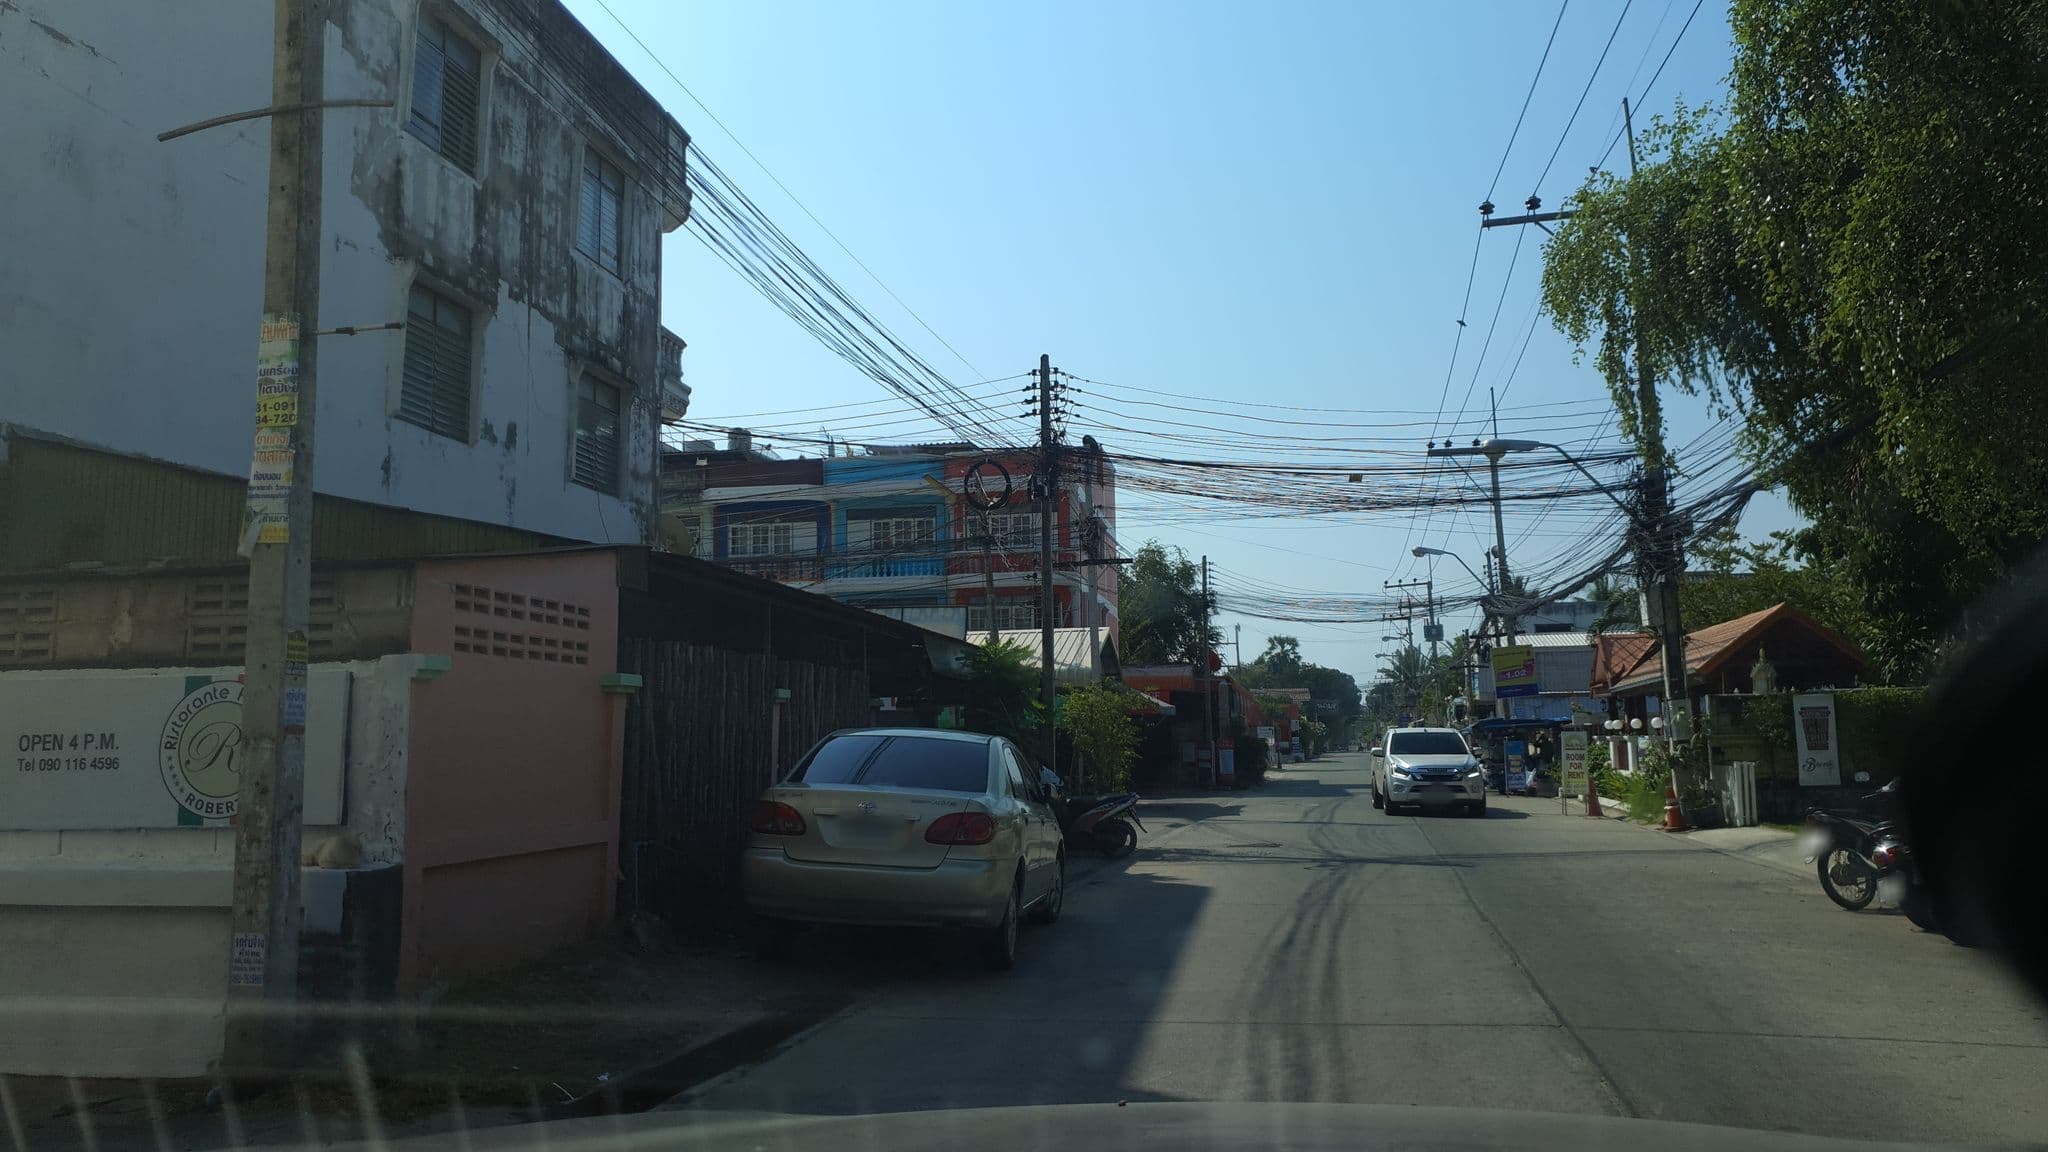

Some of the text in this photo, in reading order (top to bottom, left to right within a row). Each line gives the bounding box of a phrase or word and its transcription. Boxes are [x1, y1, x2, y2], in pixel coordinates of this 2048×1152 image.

[164, 686, 230, 750] Ristorante
[18, 732, 120, 752] OPEN 4 P.M.
[1566, 753, 1585, 761] ROOM
[17, 757, 120, 771] Tel 090 116 4596
[1569, 762, 1582, 770] FOR
[1567, 771, 1585, 779] RENT
